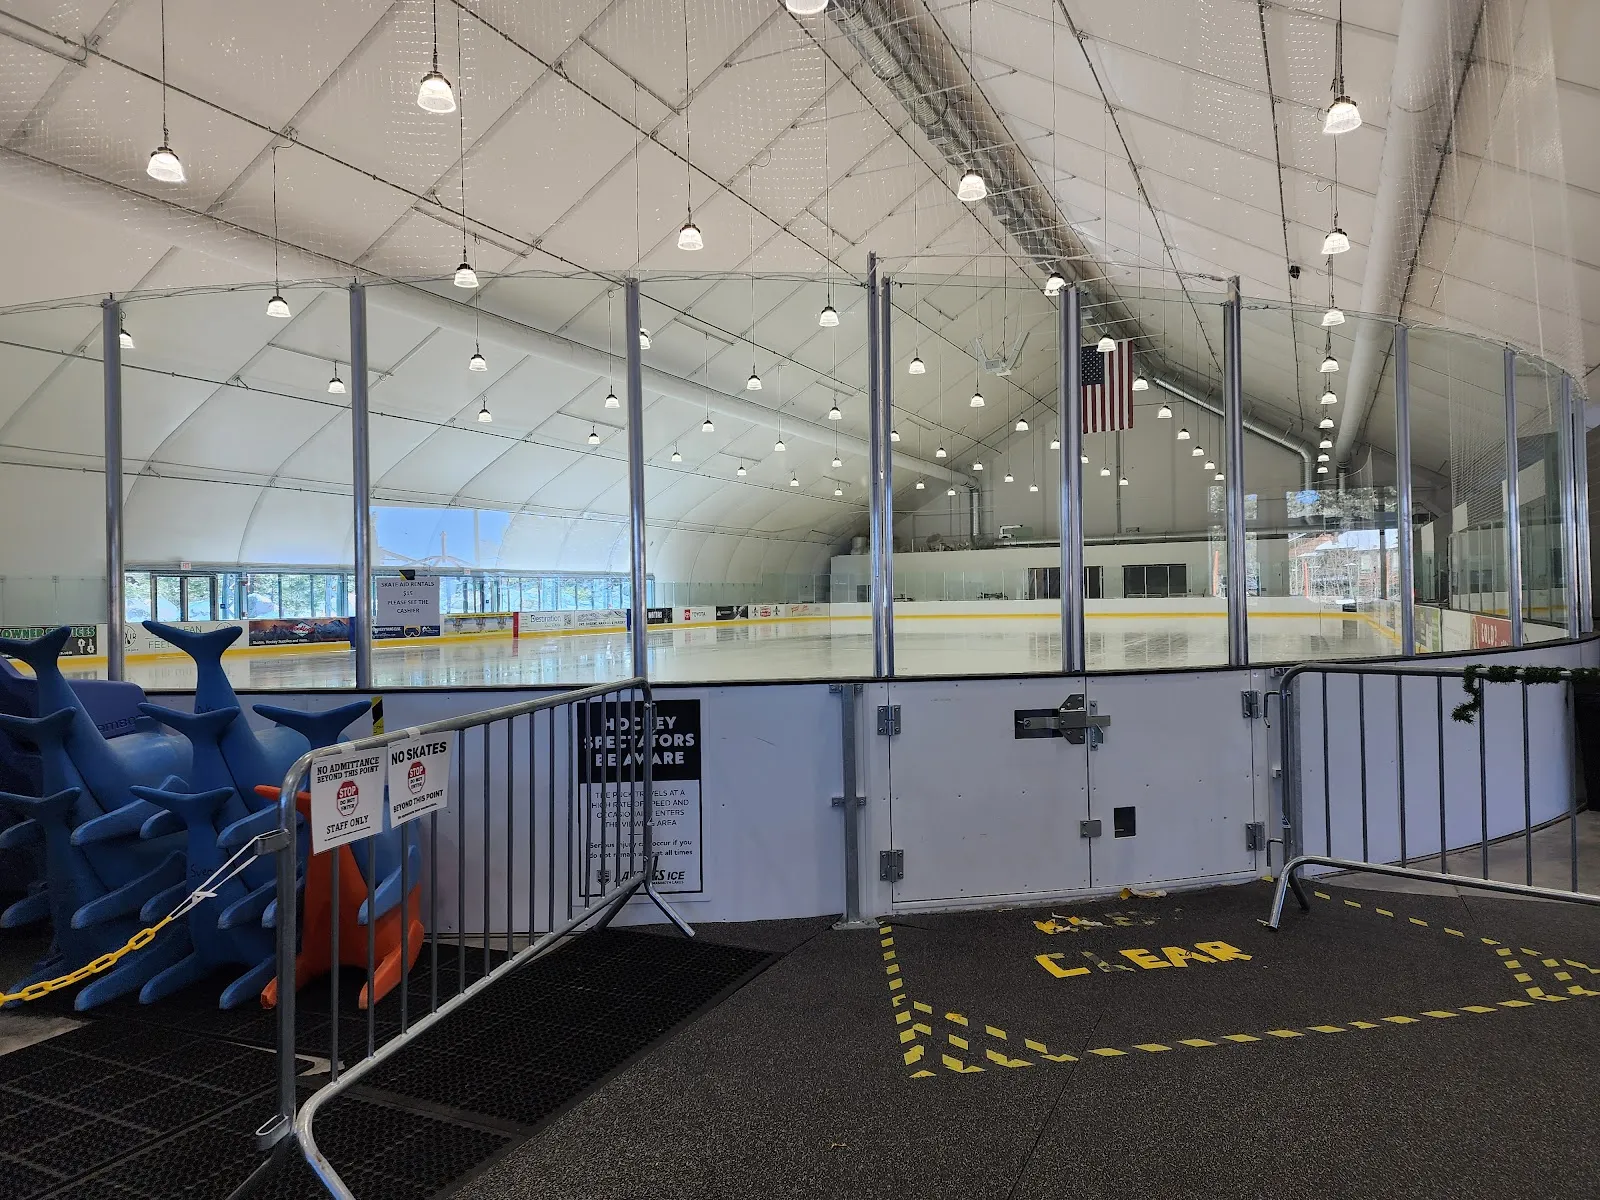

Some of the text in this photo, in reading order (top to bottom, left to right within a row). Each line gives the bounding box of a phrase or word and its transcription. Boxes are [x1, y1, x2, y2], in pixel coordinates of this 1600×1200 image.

[45, 627, 95, 638] SICES
[391, 741, 447, 766] NO SKATES
[316, 757, 380, 776] NO ADMITTANCE
[316, 765, 379, 784] BEYOND THIS POINT
[409, 765, 424, 778] STOP
[339, 785, 357, 799] STOP
[636, 789, 668, 797] TRVELS
[340, 803, 355, 811] ENTER
[393, 799, 413, 814] BEYOND
[413, 794, 426, 805] THIS
[426, 789, 444, 801] POINT
[326, 820, 349, 835] STAFF
[349, 815, 369, 828] ONLY
[667, 871, 685, 880] ICE
[1034, 940, 1253, 979] CLEAR
